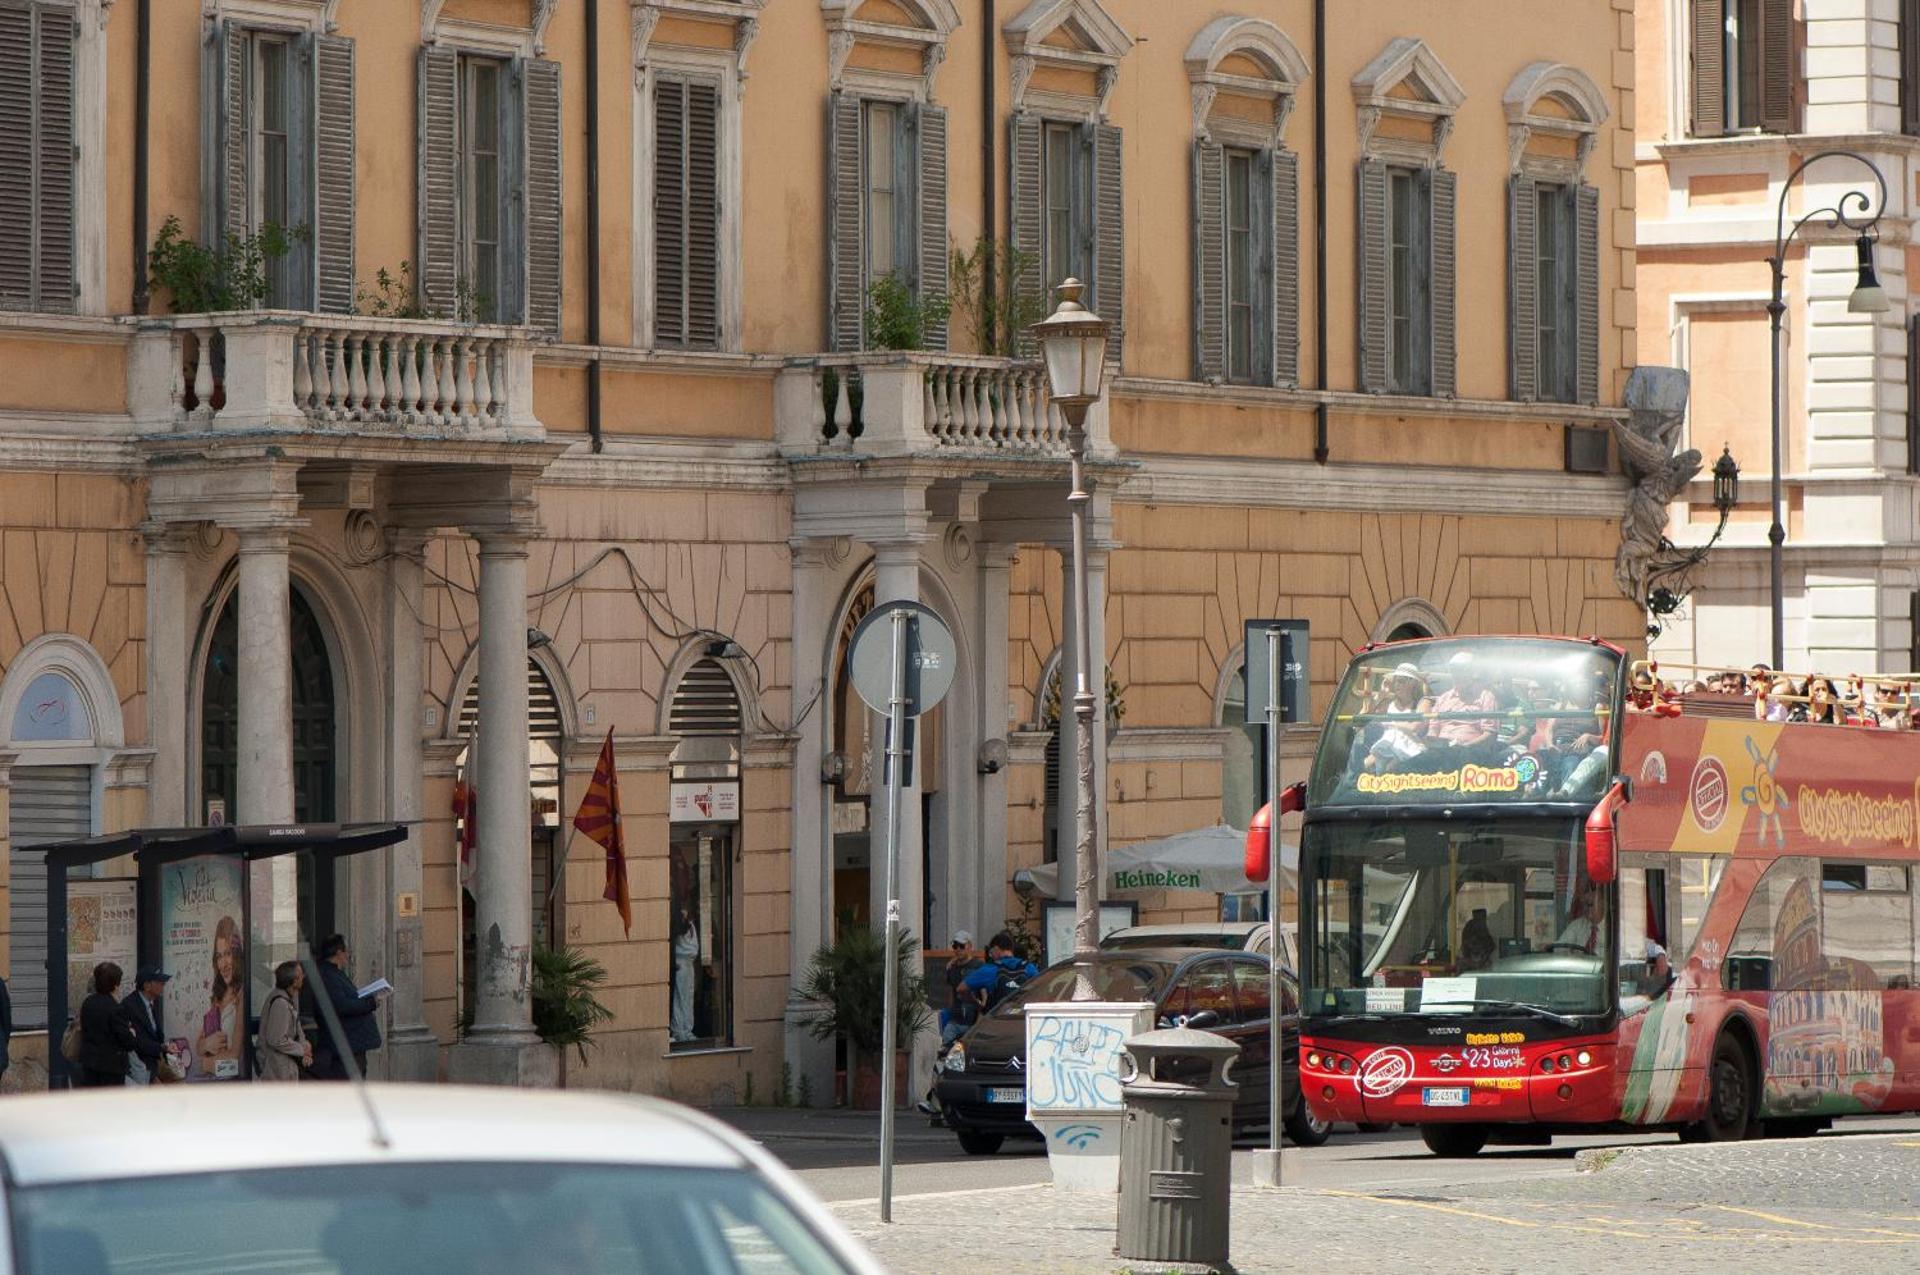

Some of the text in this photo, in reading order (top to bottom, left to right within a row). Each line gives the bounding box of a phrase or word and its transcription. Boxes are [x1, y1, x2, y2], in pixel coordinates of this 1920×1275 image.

[1358, 766, 1517, 791] CitySightseeing Roma
[1798, 785, 1912, 847] CitySightseeing
[1115, 870, 1200, 888] Heineken
[1428, 1027, 1461, 1035] VOLVO
[1493, 1057, 1513, 1069] Days
